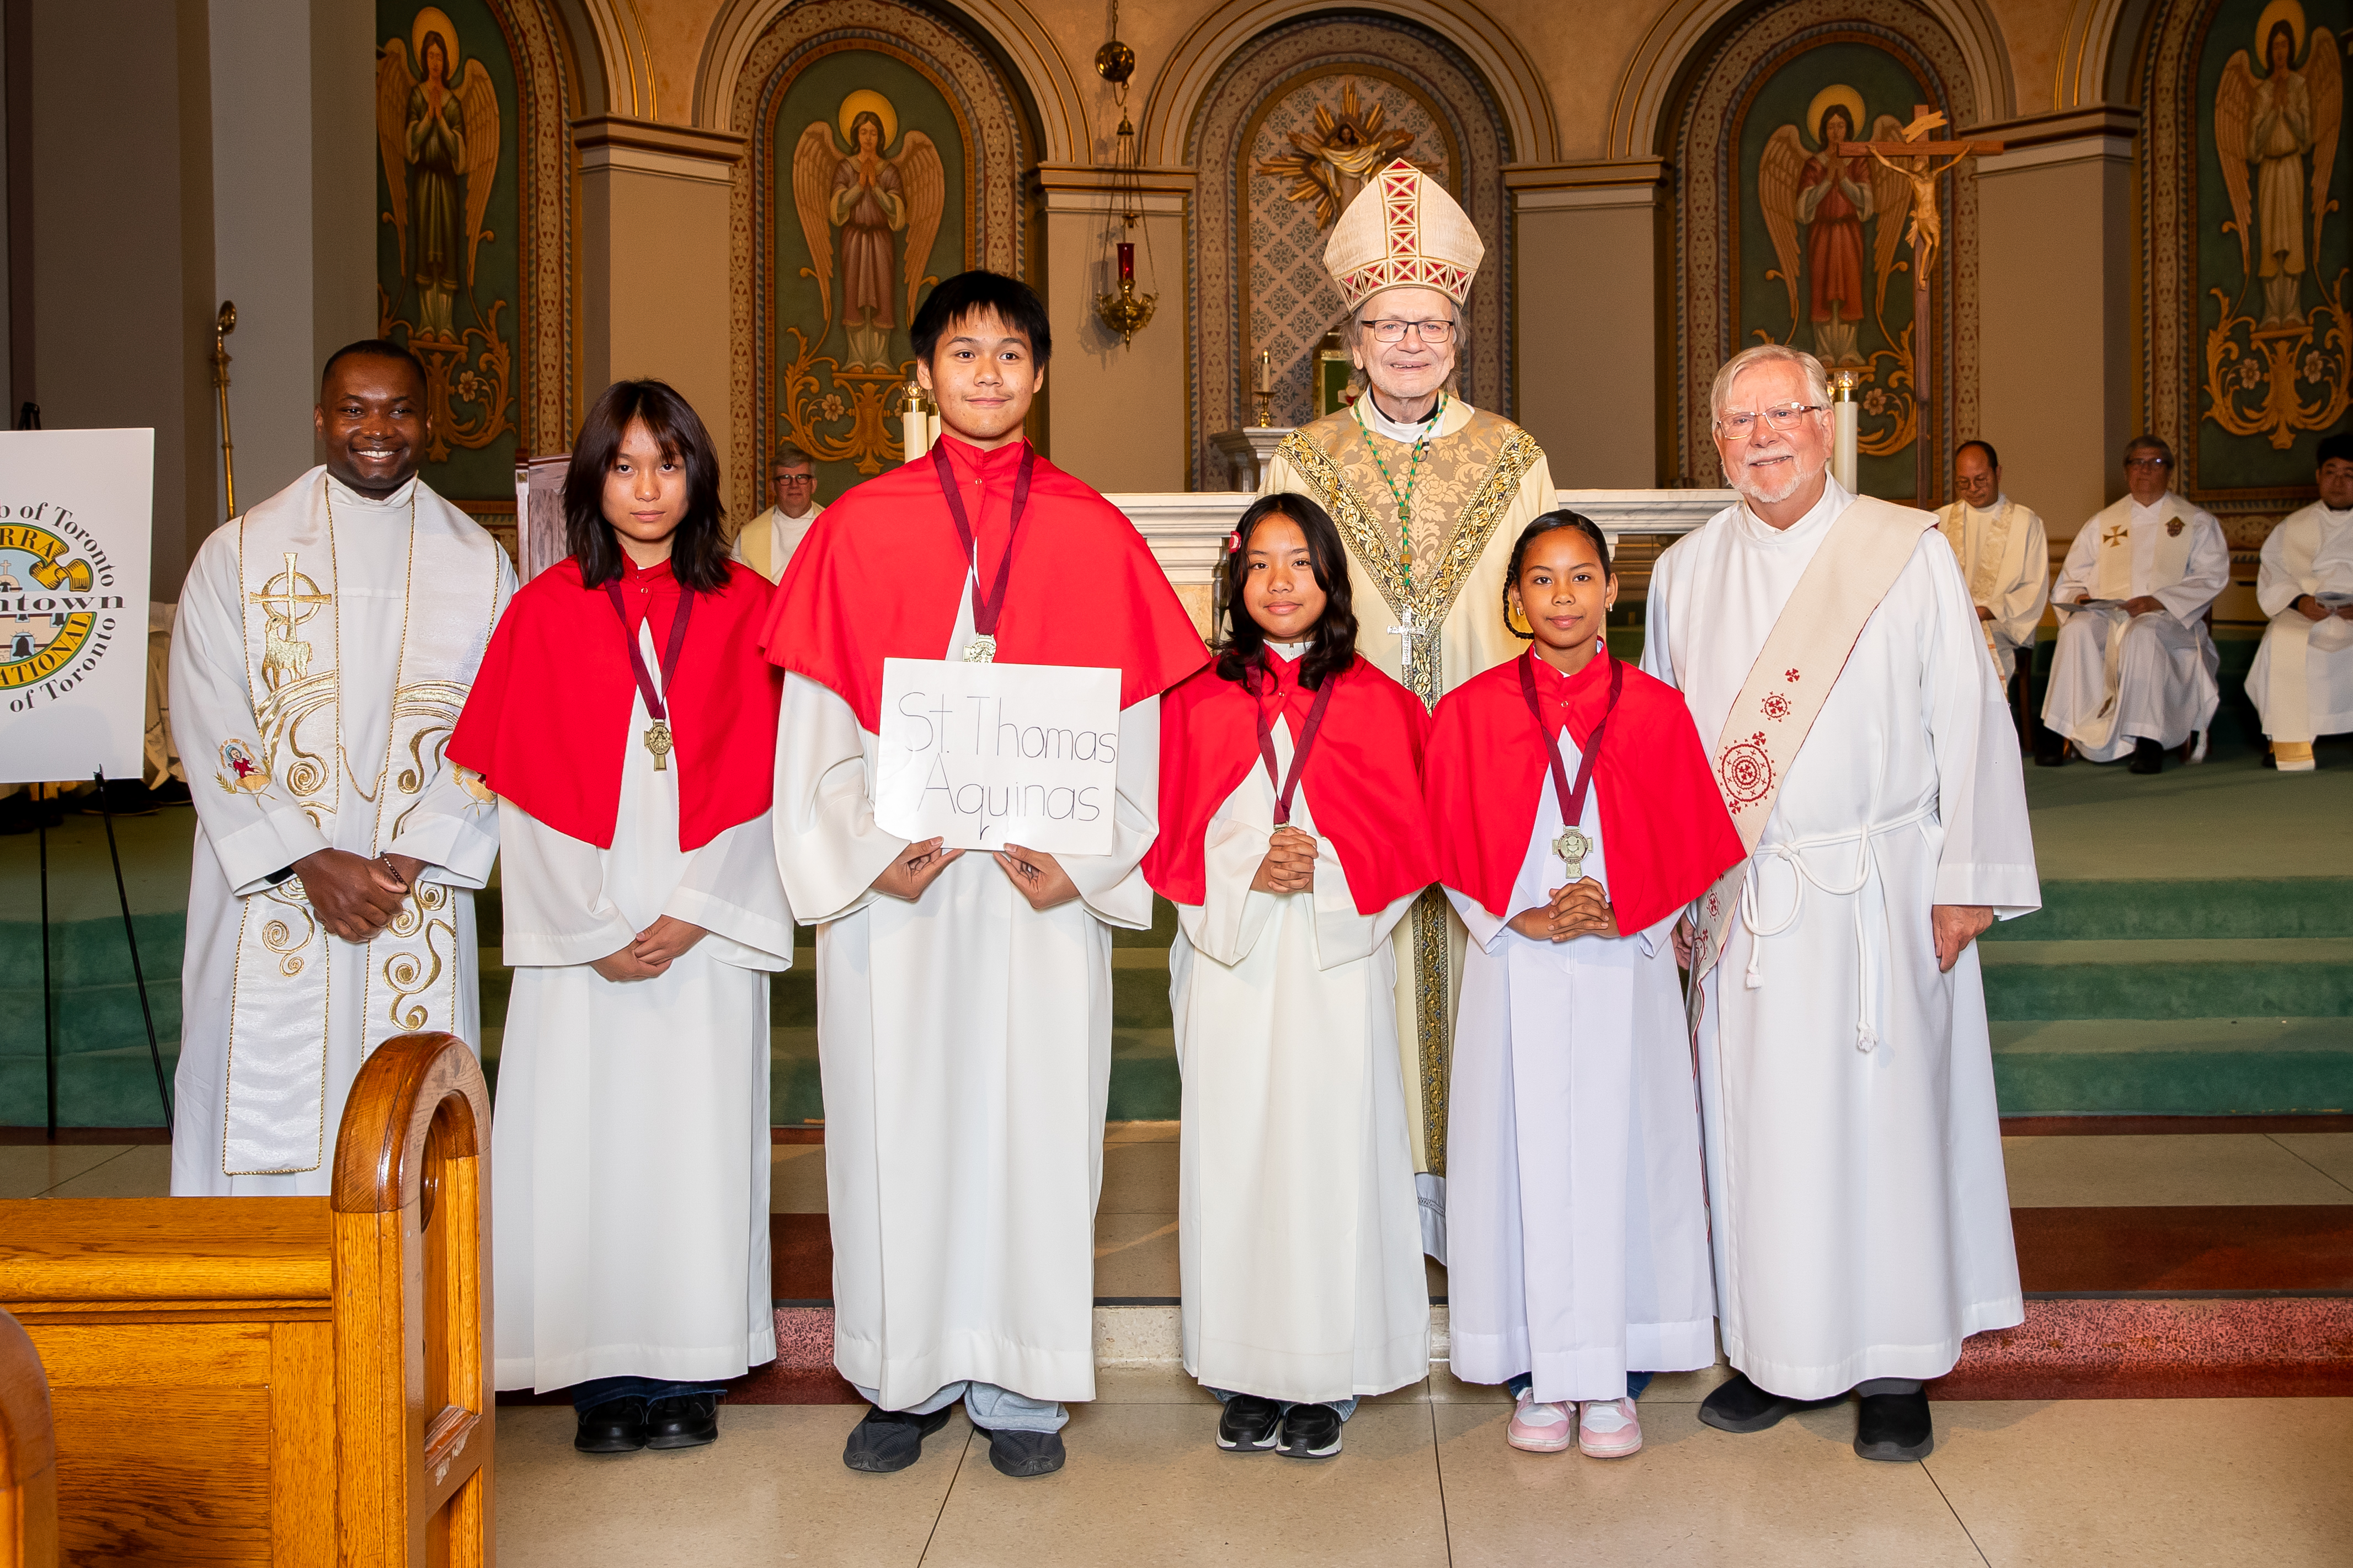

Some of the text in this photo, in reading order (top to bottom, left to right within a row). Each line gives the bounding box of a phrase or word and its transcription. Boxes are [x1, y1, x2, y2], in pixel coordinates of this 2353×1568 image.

[20, 502, 49, 521] of
[52, 506, 116, 587] Toronto
[10, 618, 116, 713] of Toronto
[899, 692, 1117, 763] St. Thomas
[917, 752, 1100, 841] Aquinas
